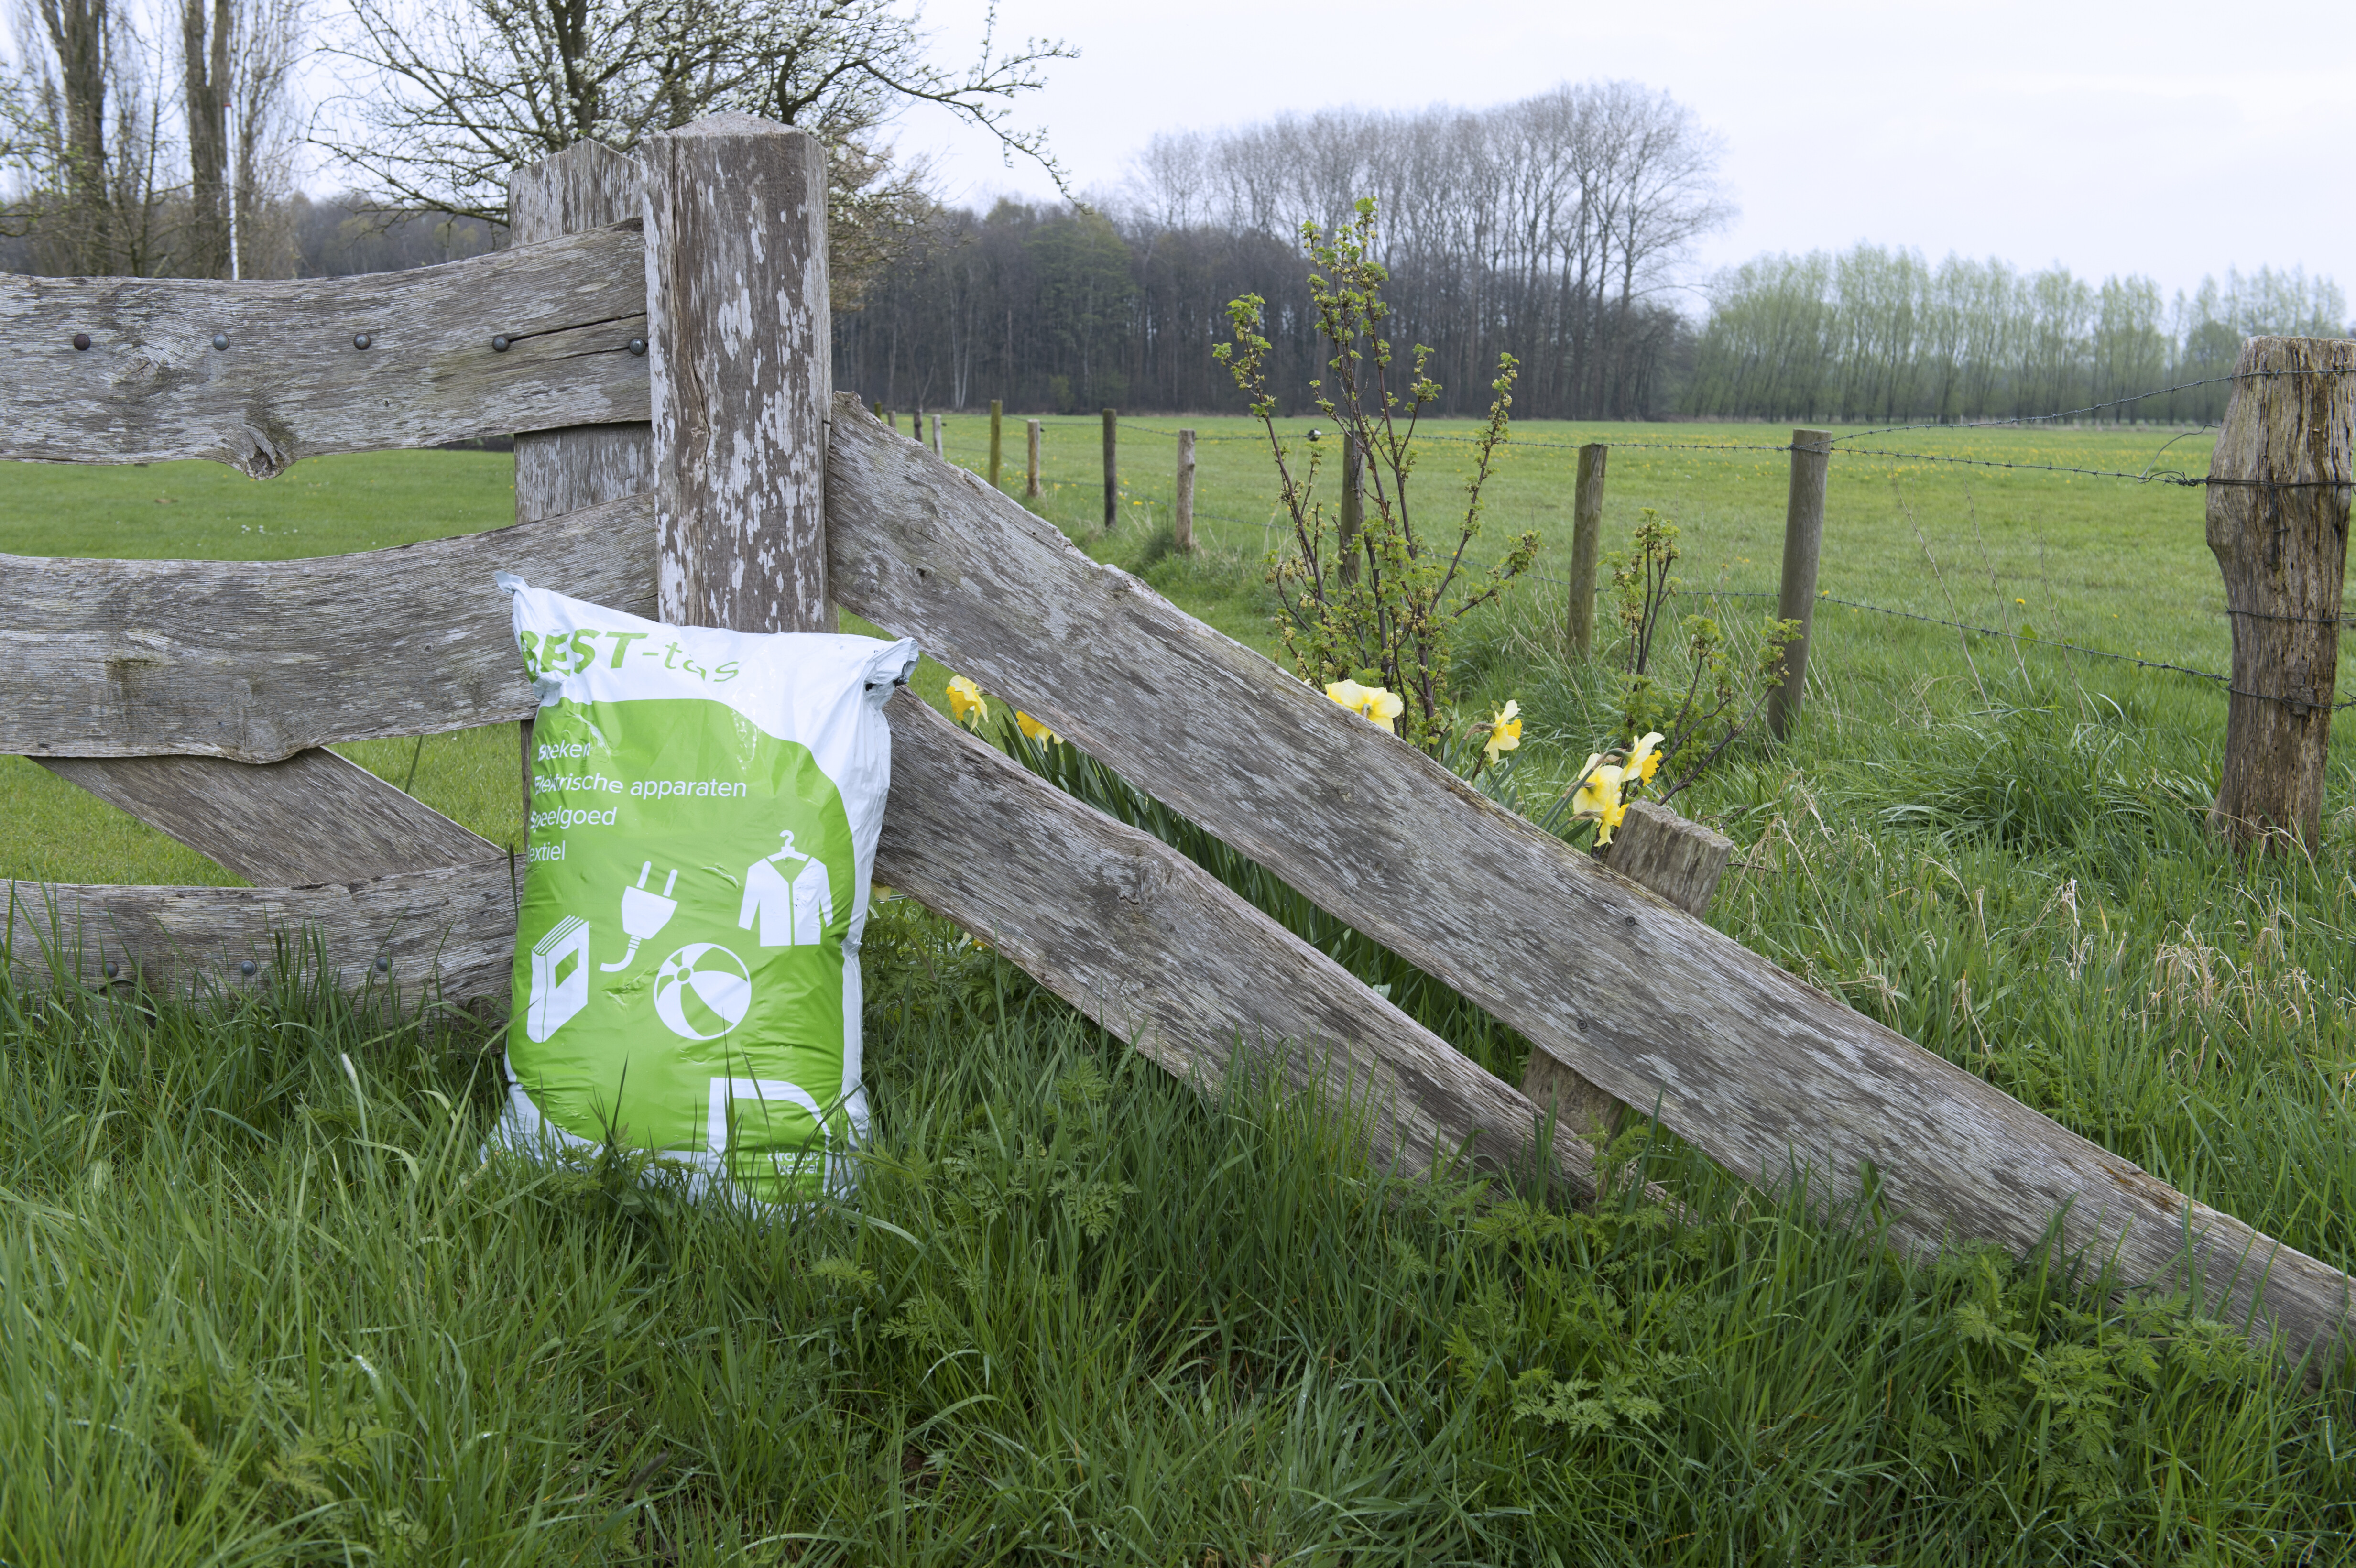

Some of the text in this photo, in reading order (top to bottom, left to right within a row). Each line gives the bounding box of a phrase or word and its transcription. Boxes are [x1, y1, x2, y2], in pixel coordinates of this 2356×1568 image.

[534, 773, 746, 800] Elektrische apparaten
[530, 806, 617, 833] Speelgoed
